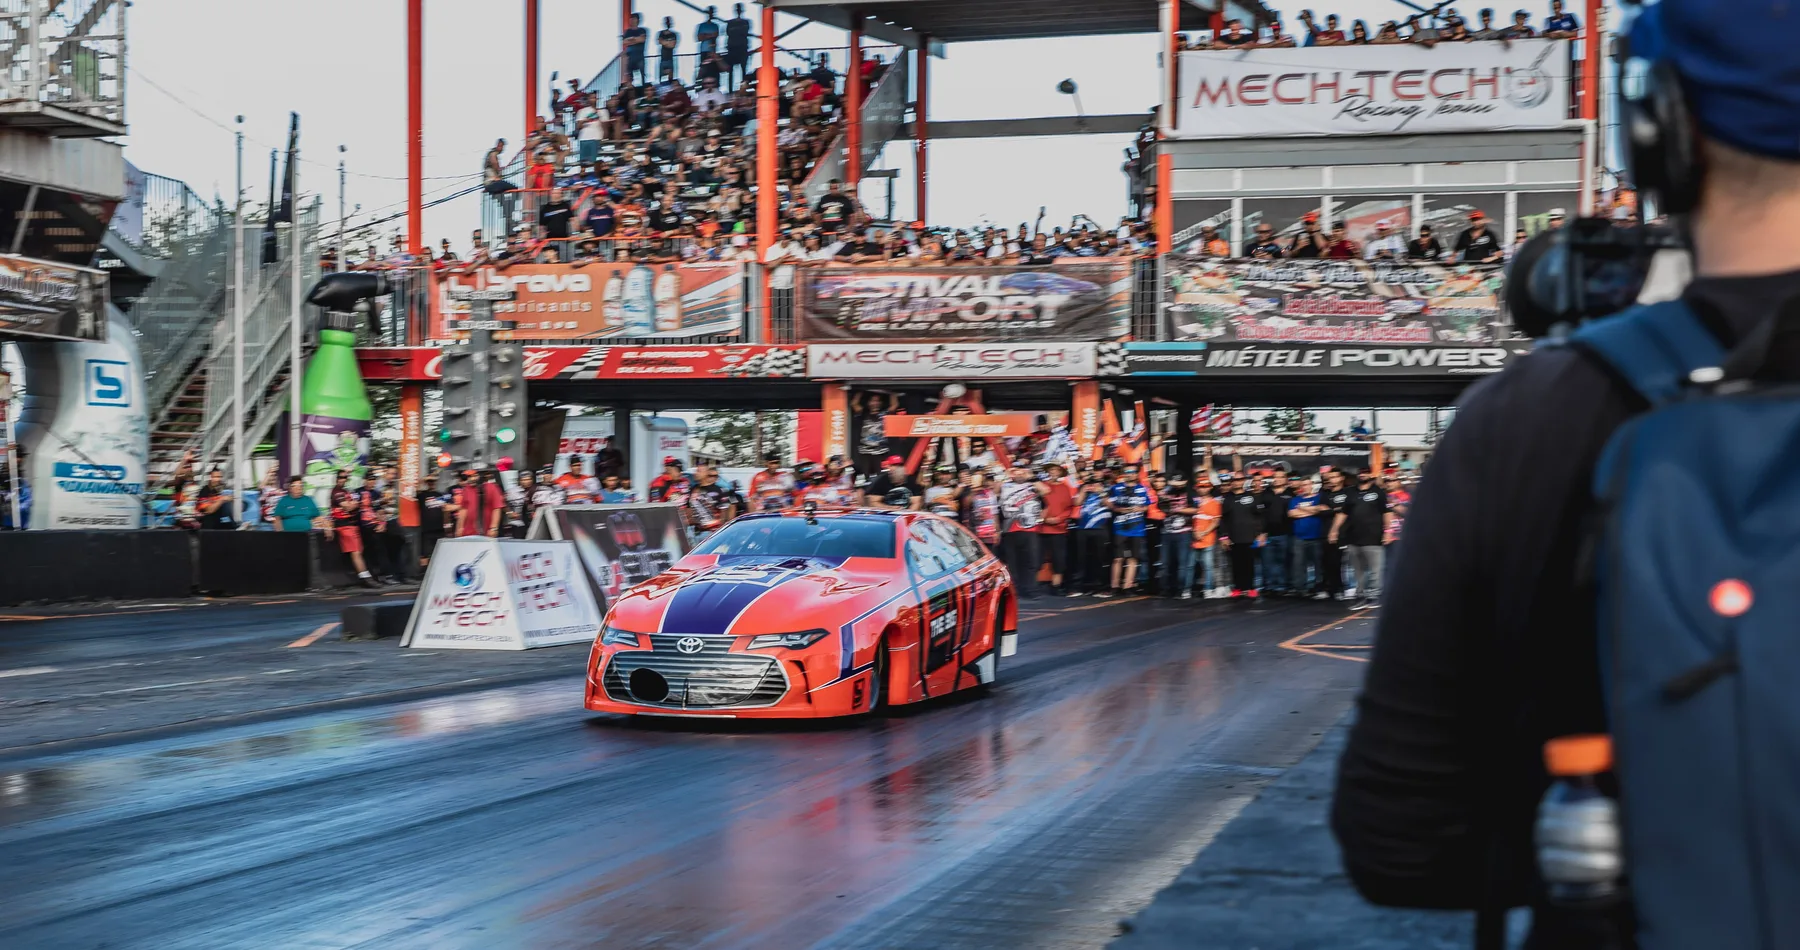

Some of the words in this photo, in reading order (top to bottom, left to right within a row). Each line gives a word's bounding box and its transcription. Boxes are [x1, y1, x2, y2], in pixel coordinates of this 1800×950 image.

[1192, 67, 1499, 108] MECH-TECH
[1333, 93, 1427, 131] Racing
[1426, 96, 1497, 118] Team
[486, 267, 592, 293] brava
[857, 322, 886, 330] DE
[888, 322, 929, 330] LAS
[928, 320, 1056, 330] AMERICAS
[819, 349, 1065, 364] MECH-TECH
[1205, 345, 1326, 368] MÉTELE
[1330, 348, 1508, 367] POWER
[427, 592, 504, 610] MECH
